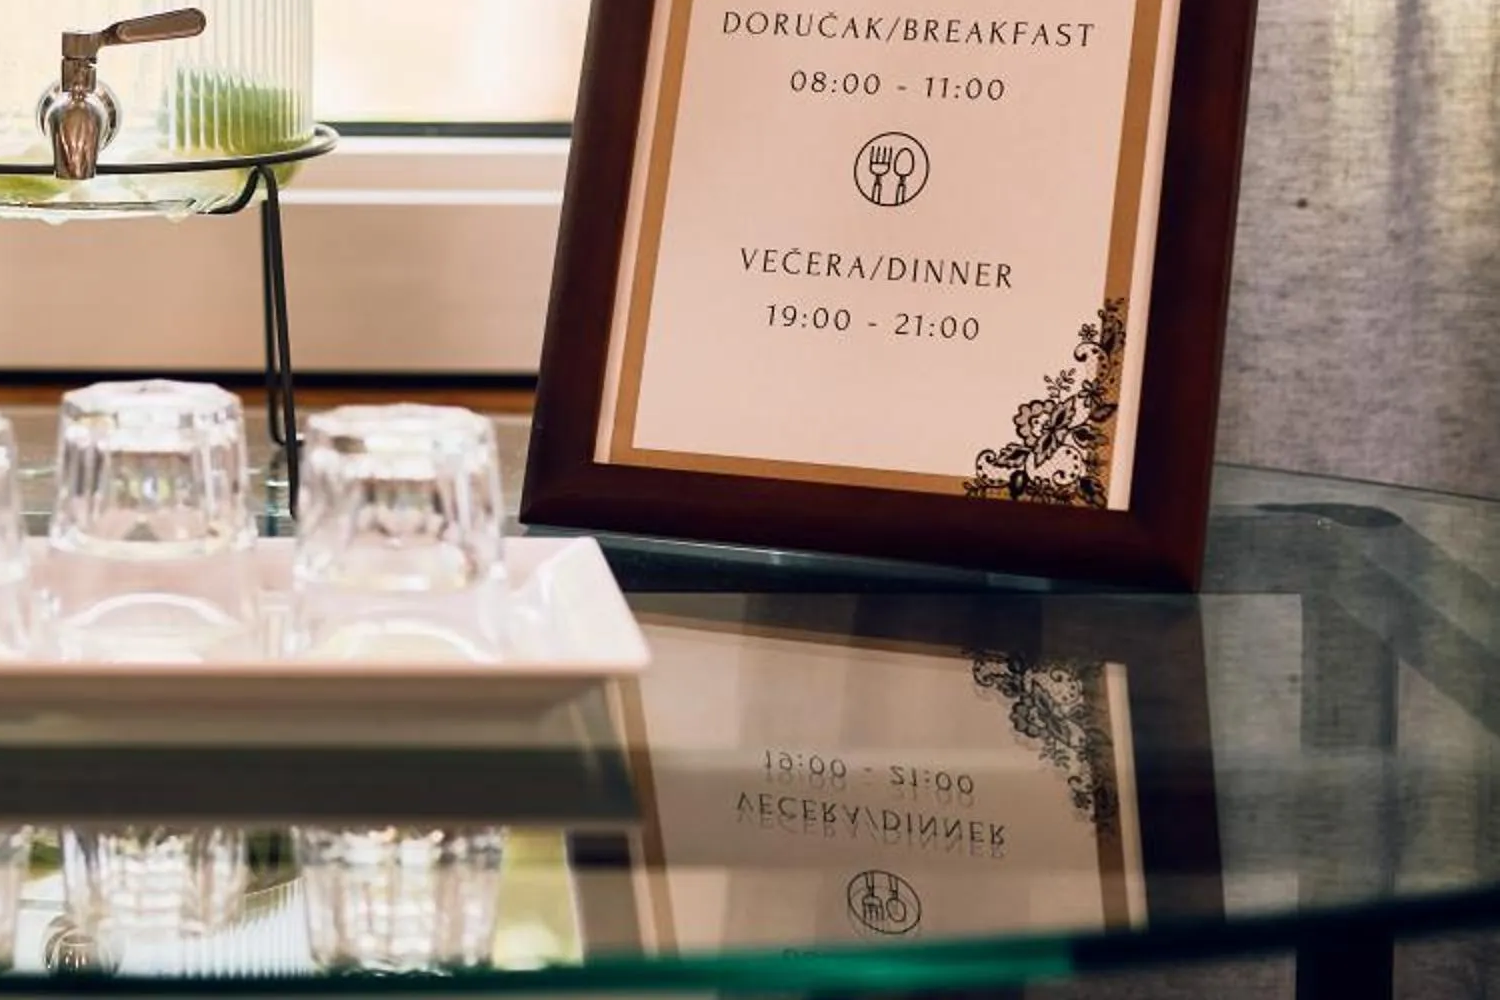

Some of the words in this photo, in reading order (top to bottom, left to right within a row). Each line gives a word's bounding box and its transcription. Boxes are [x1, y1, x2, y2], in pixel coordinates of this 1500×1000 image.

[722, 8, 1095, 47] DORUČAK/BREAKFAST
[789, 69, 882, 97] 08:00
[924, 74, 1007, 102] 11:00
[740, 246, 1012, 288] VEČERA/DINNER
[765, 302, 852, 332] 19:00
[893, 312, 980, 341] 21:00
